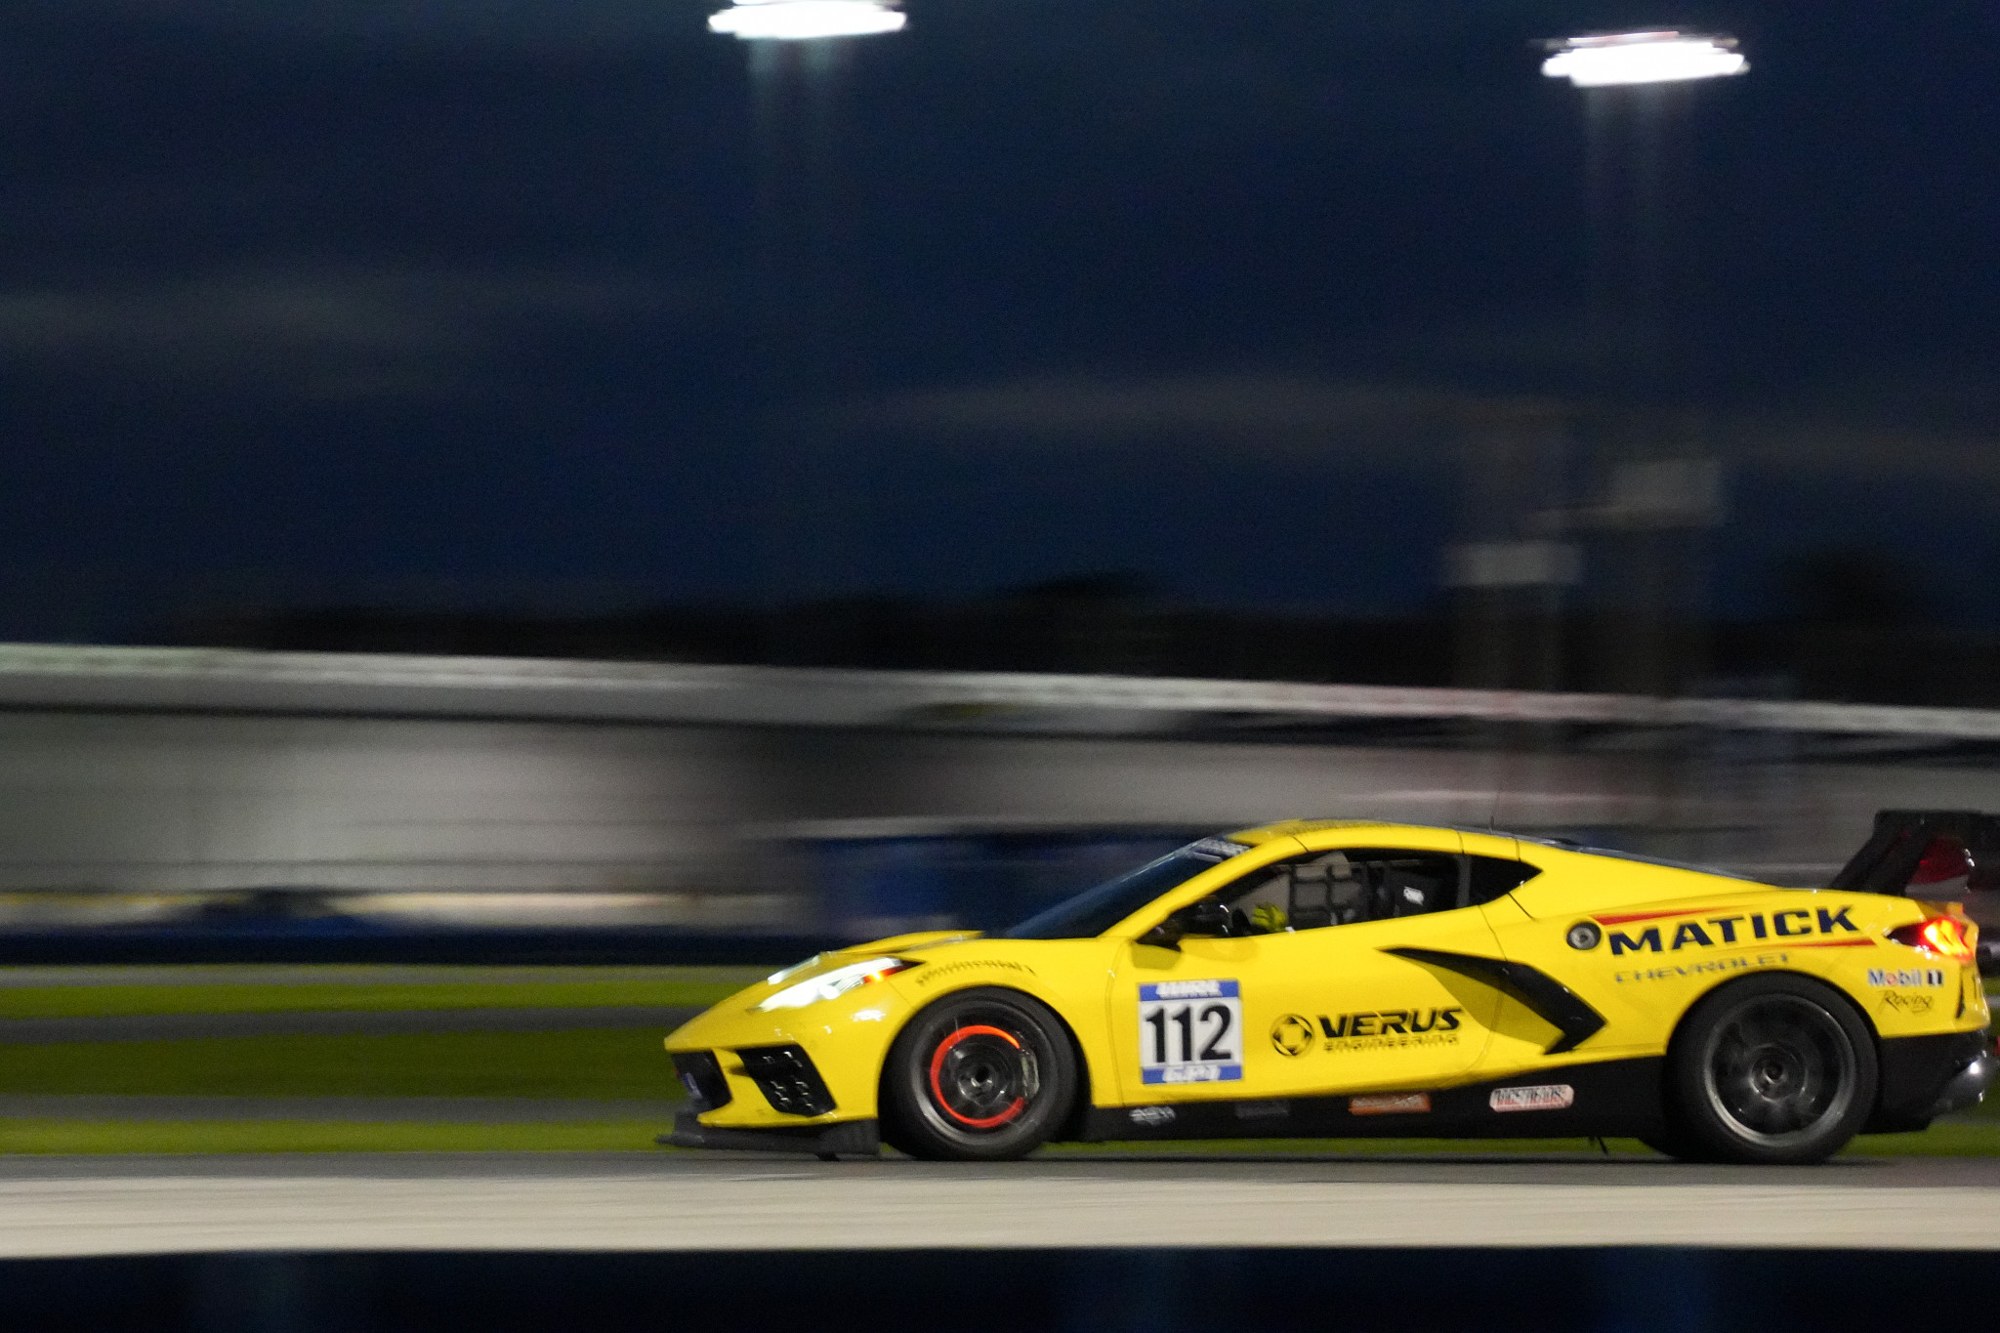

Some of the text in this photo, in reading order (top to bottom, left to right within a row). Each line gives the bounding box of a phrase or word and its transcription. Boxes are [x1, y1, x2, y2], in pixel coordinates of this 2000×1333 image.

[1608, 904, 1861, 956] MATICK
[1614, 953, 1790, 984] CHEVROLET
[1868, 968, 1922, 987] Mobil
[1878, 989, 1935, 1014] Racing
[1143, 1002, 1234, 1064] 112
[1317, 1007, 1463, 1039] VERUS
[1323, 1034, 1460, 1053] ENGINEERING
